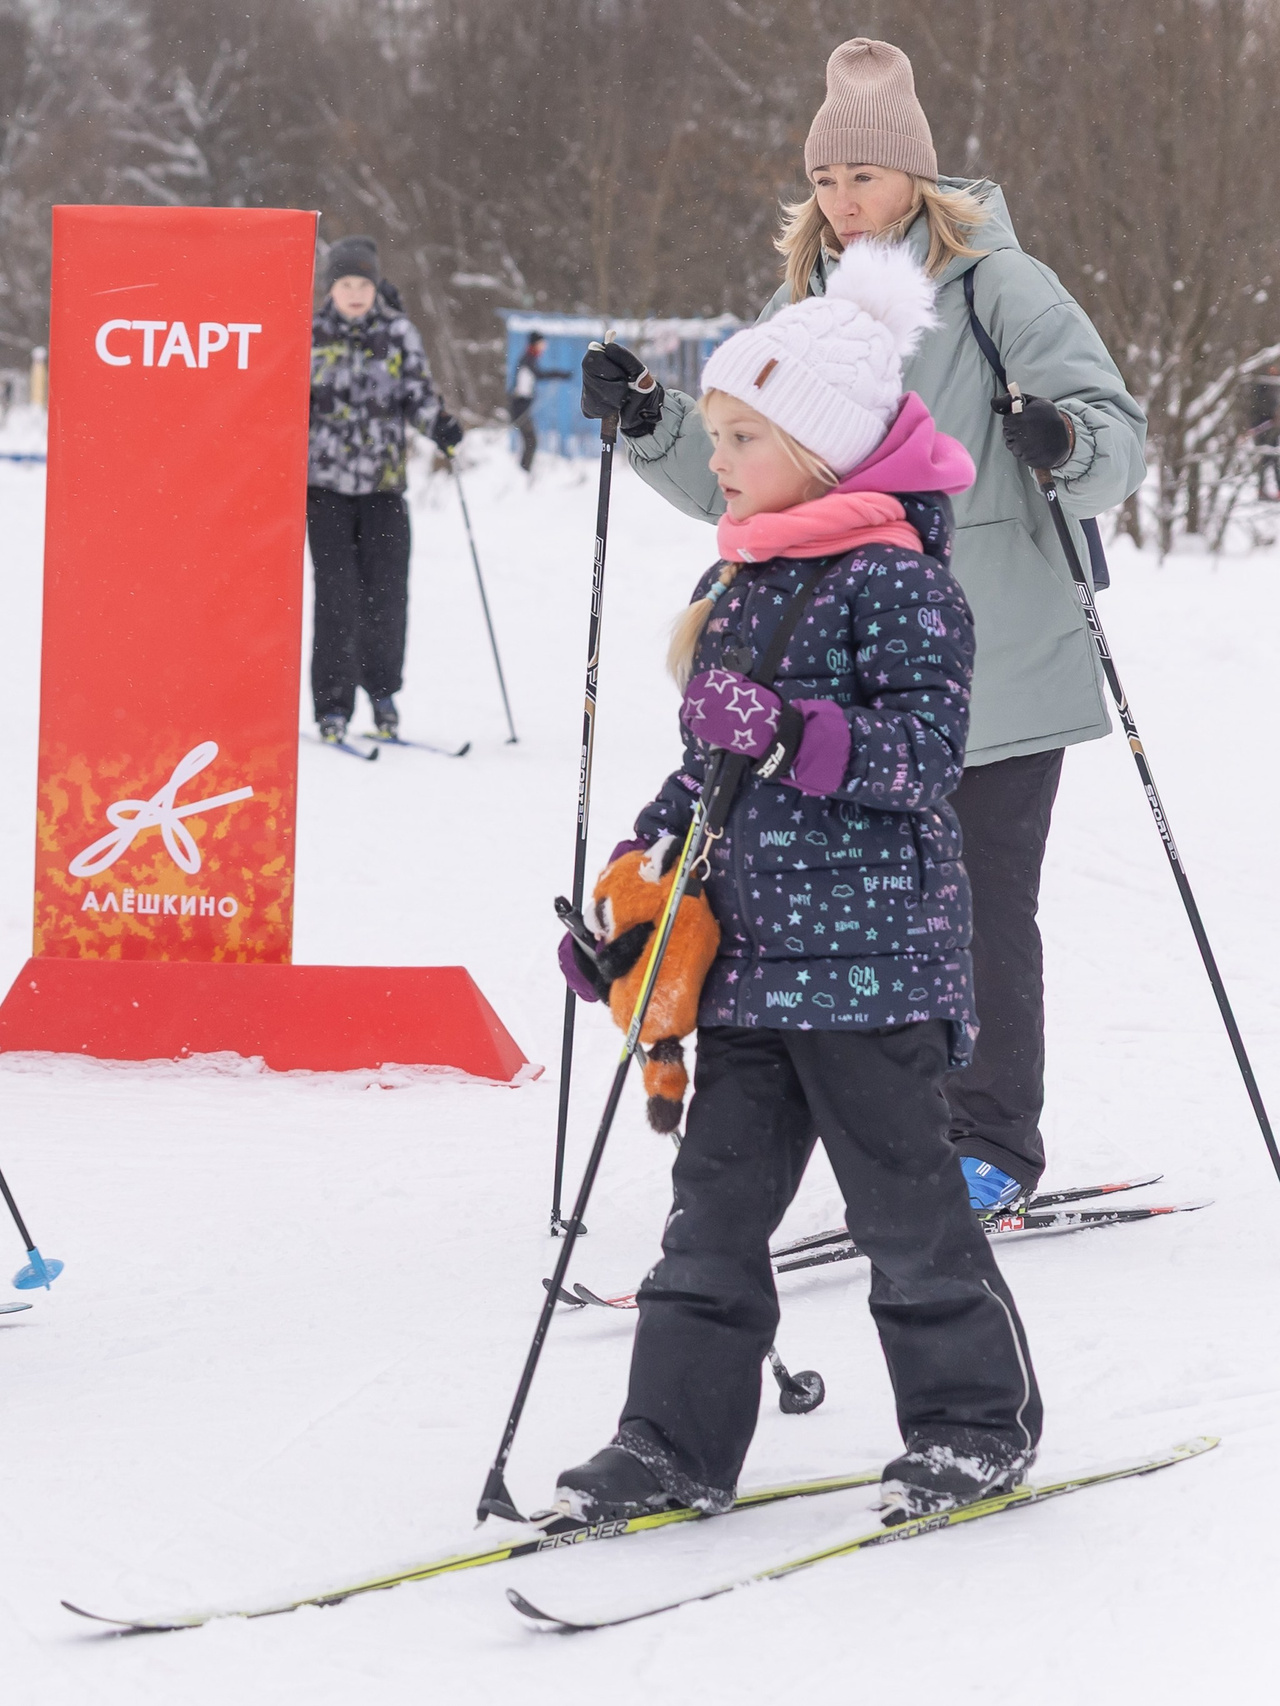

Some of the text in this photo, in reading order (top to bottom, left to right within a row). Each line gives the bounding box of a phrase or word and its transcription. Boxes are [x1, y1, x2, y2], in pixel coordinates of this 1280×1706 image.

[95, 319, 262, 369] СТАРТ
[760, 830, 797, 848] DANCE
[863, 875, 914, 893] BE FREE
[81, 888, 238, 917] АЛЁШКИНО
[848, 965, 879, 988] GIRL
[856, 979, 880, 997] PWR
[766, 991, 803, 1008] DANCE
[537, 1519, 628, 1551] FISCHER
